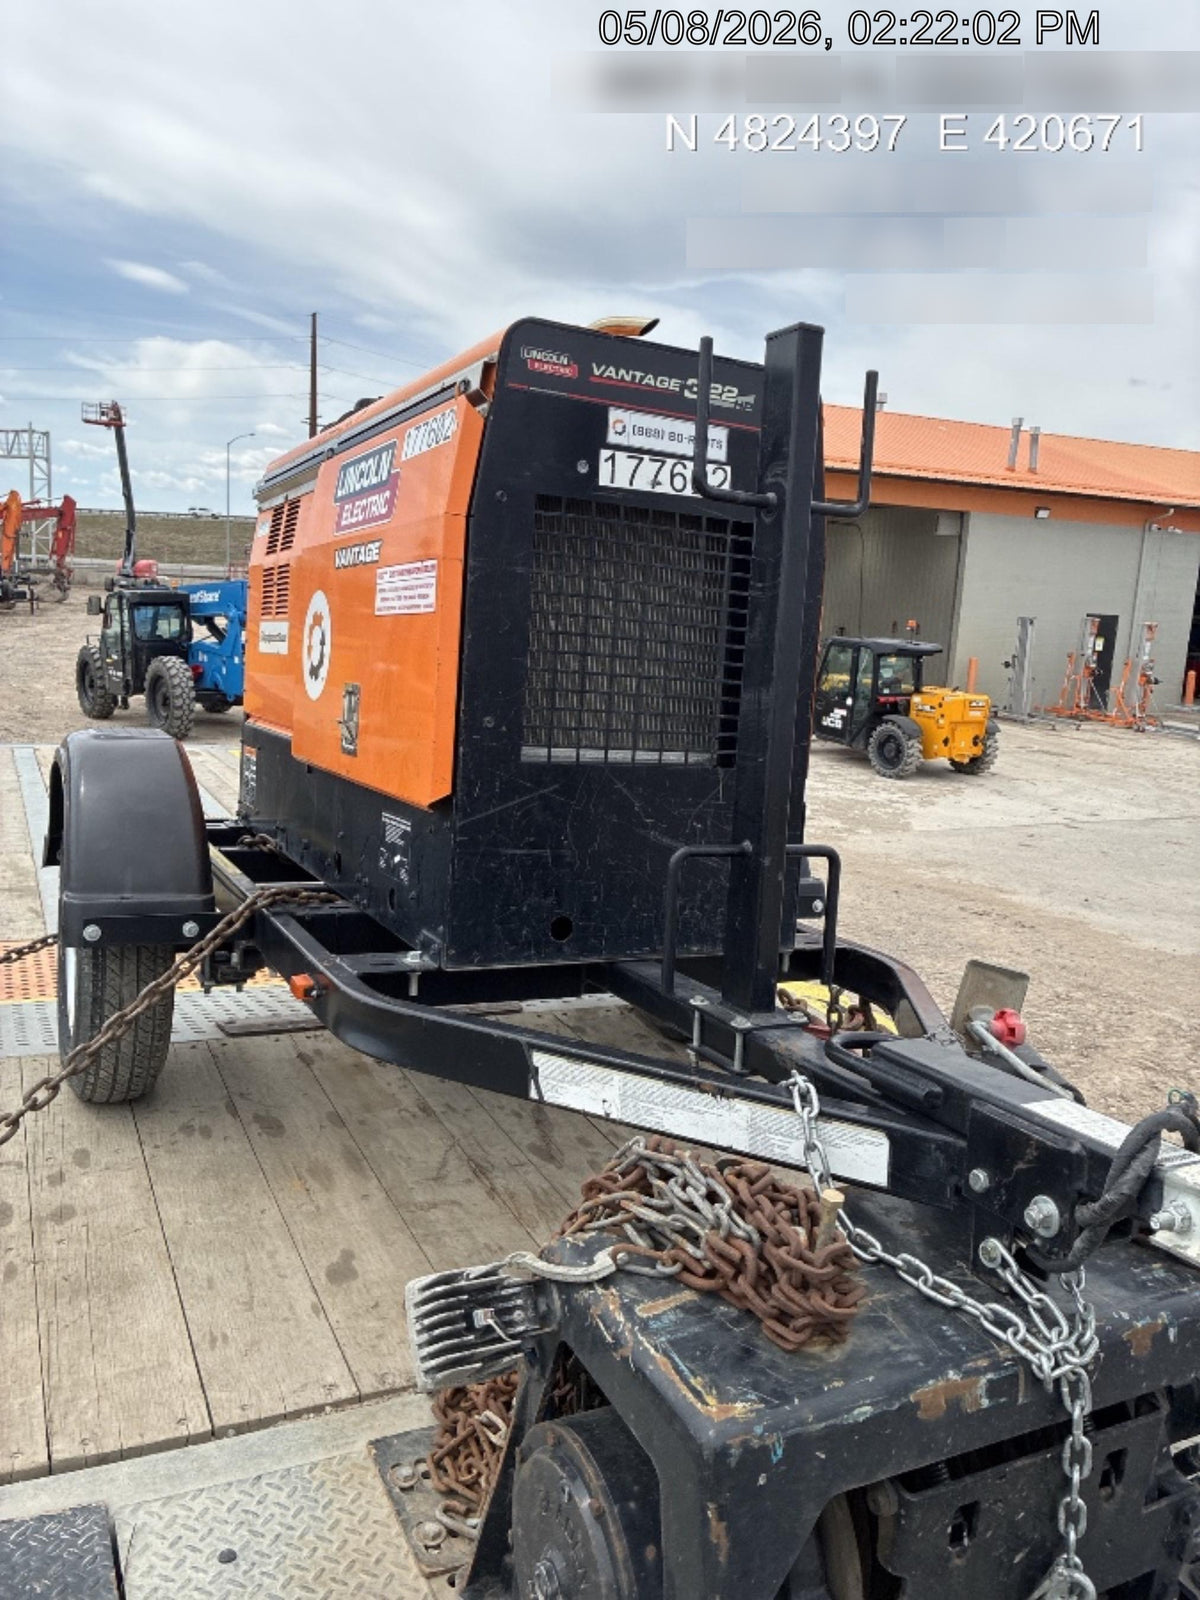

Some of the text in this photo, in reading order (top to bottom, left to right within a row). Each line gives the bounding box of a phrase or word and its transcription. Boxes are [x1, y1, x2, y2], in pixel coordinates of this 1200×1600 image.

[523, 346, 569, 366] LINCOLN
[591, 362, 683, 392] VANTAGE
[336, 447, 393, 498] LINCOLN
[603, 452, 729, 494] 17762
[340, 489, 392, 527] ELECTRIC
[334, 541, 382, 569] VANTAGE
[821, 716, 843, 730] JCB
